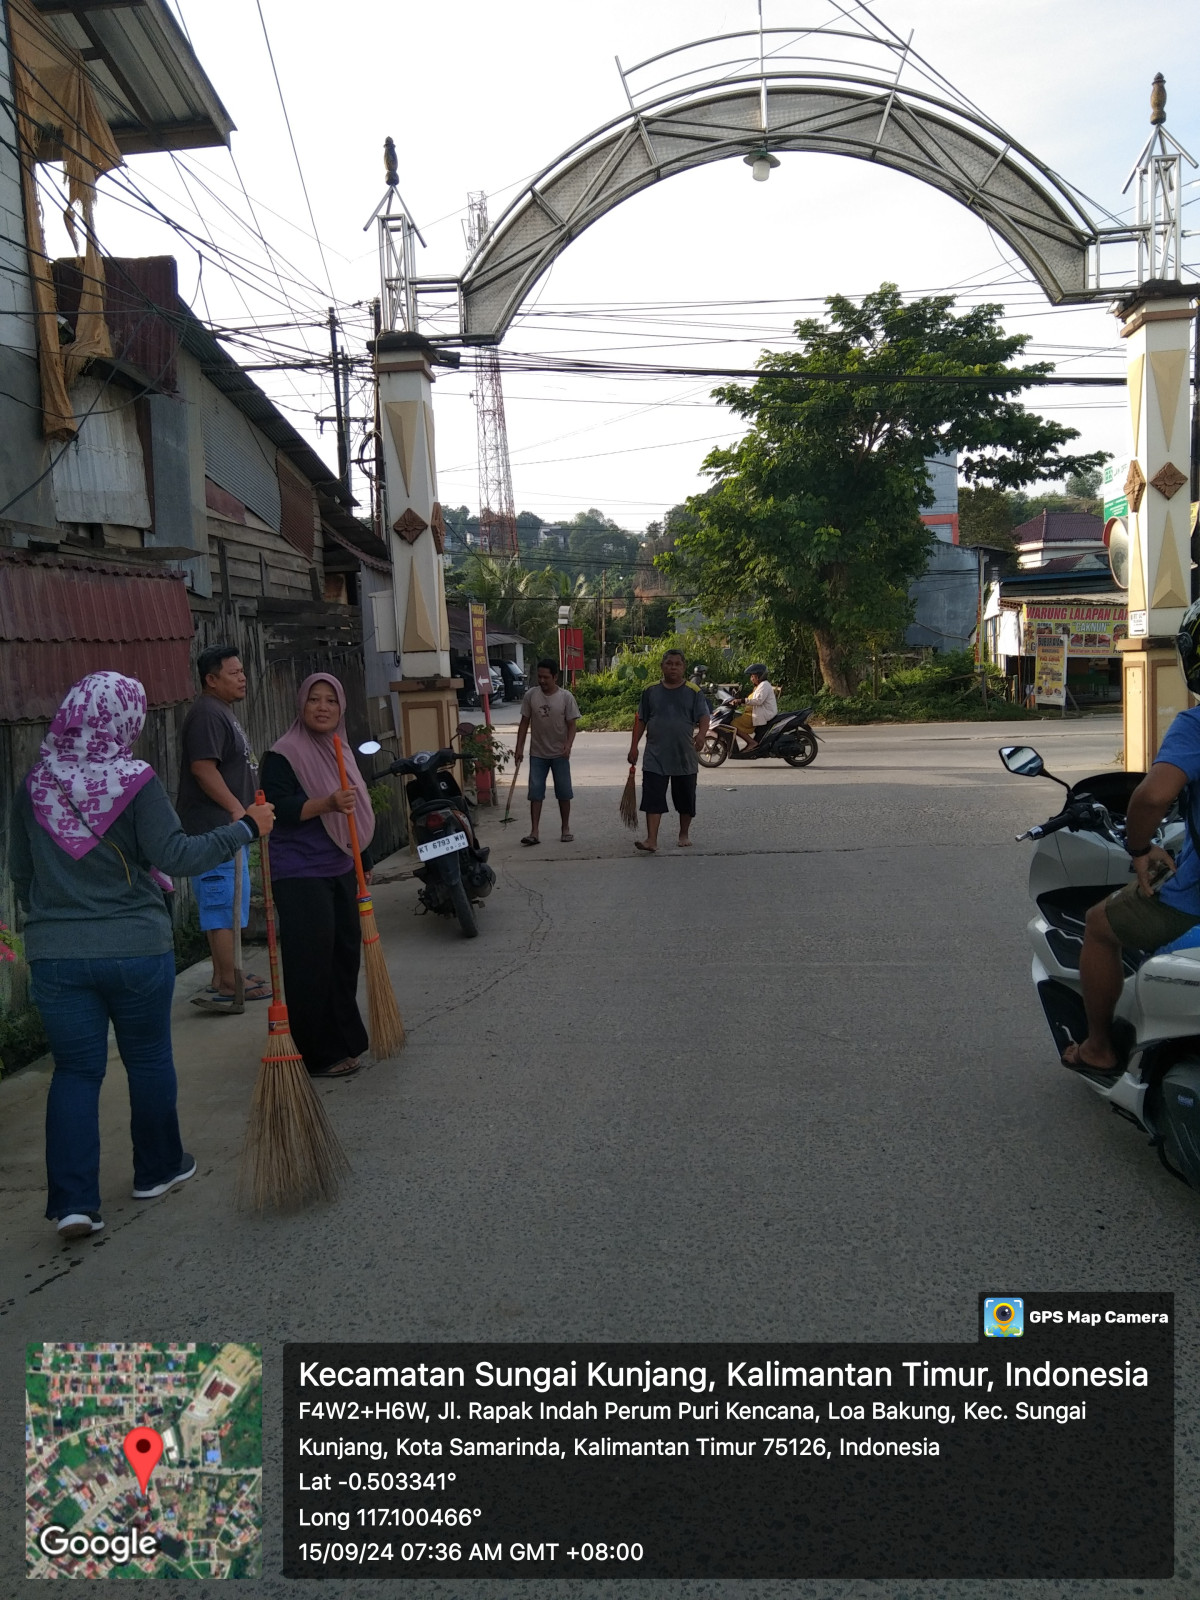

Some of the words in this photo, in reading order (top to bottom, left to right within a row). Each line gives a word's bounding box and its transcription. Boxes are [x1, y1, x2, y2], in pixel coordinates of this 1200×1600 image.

[1026, 607, 1067, 619] WARUNG
[1069, 608, 1111, 620] LALAPAN
[419, 845, 429, 853] KT
